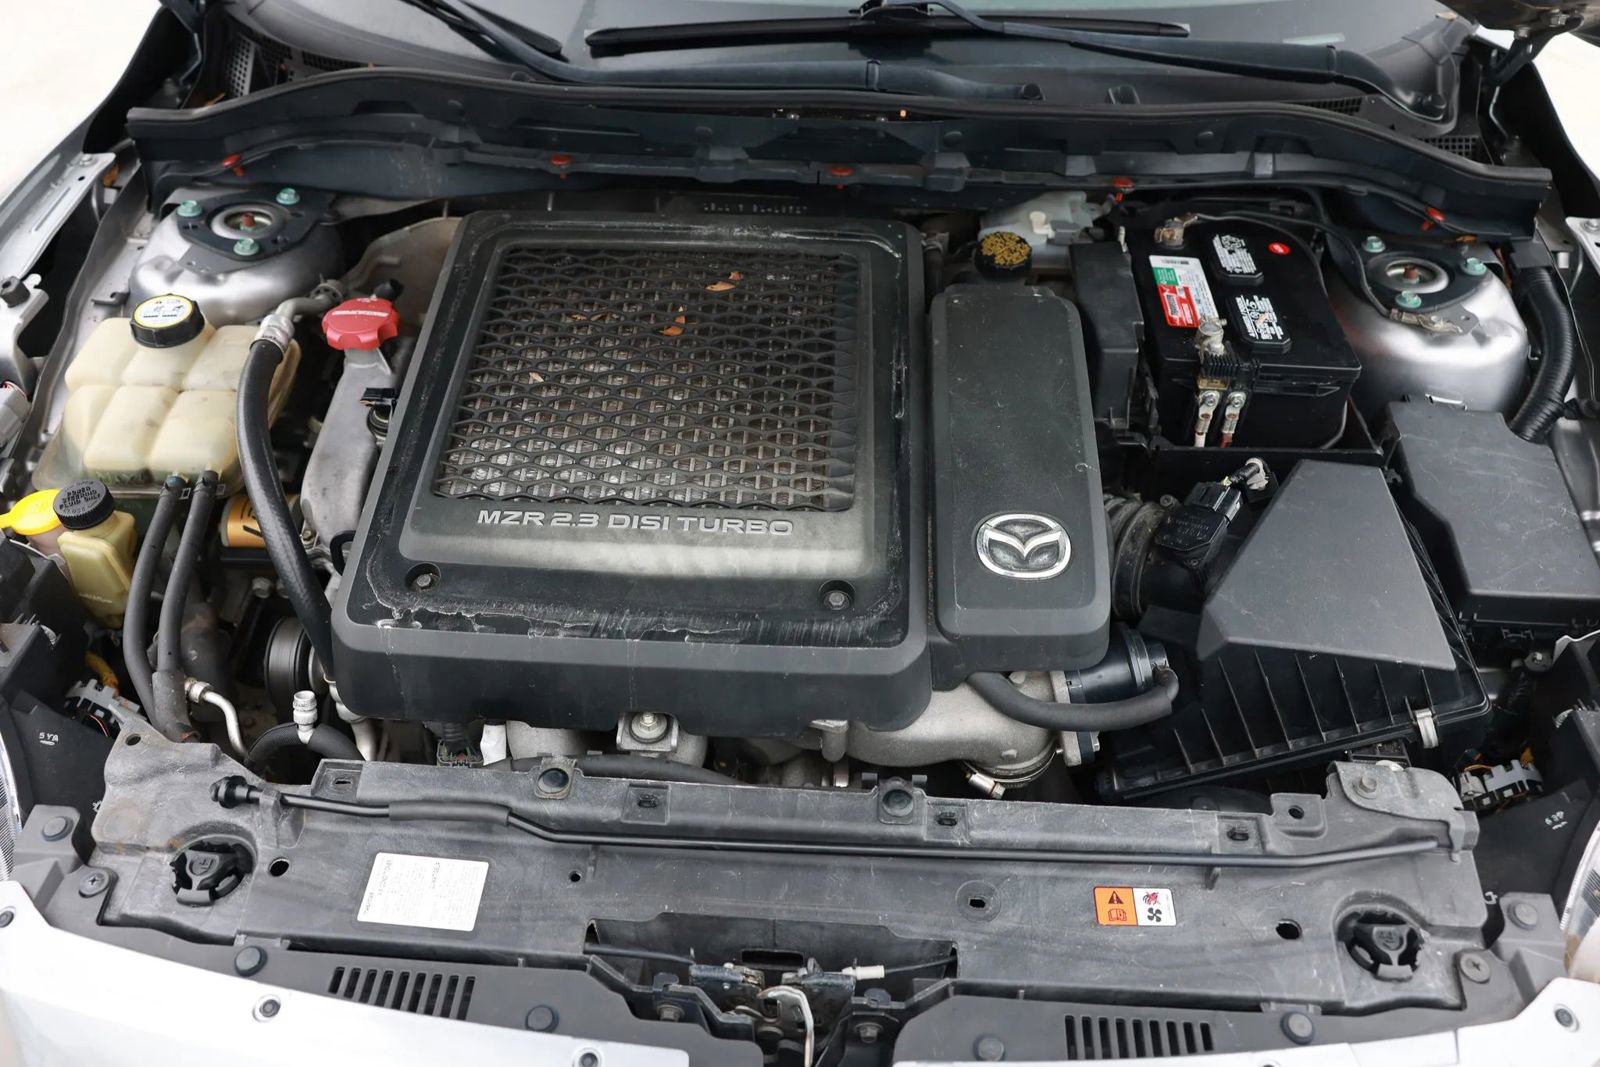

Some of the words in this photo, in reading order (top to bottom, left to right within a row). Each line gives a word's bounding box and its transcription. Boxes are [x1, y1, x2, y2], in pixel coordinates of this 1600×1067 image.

[477, 509, 545, 526] MZR
[550, 512, 599, 528] 2.3
[608, 514, 670, 530] DISI
[677, 516, 794, 536] TURBO
